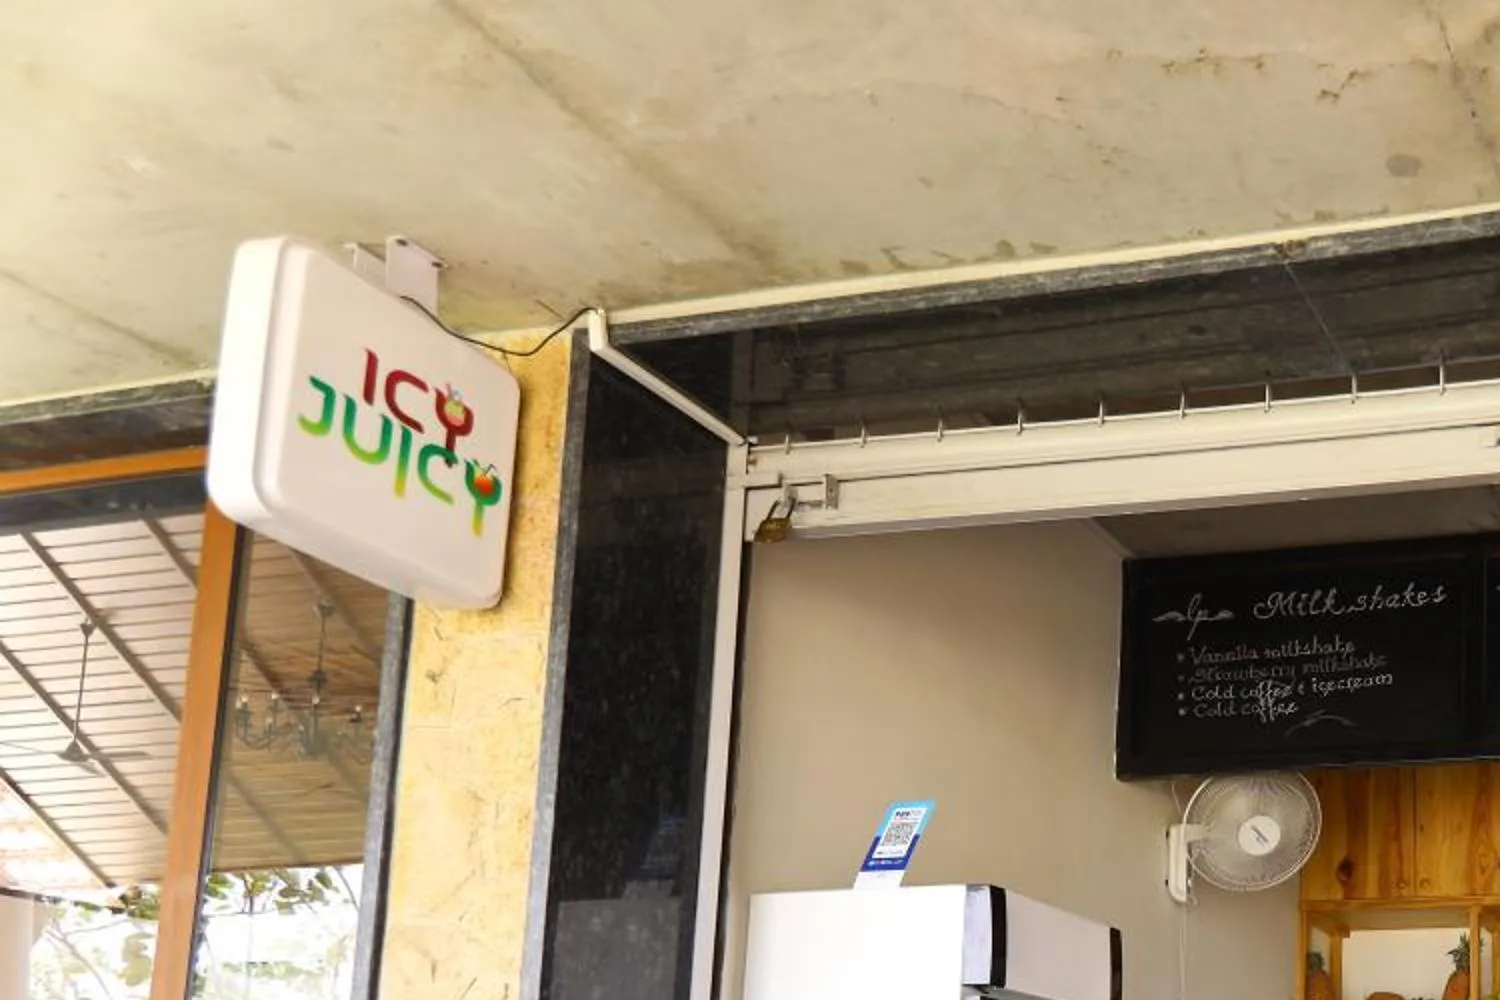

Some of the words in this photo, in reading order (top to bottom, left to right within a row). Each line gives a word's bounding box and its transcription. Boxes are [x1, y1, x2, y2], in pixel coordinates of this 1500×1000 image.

[364, 347, 474, 468] ICY
[296, 374, 503, 538] JUICY
[1252, 588, 1346, 619] Milk
[1191, 683, 1236, 701] Cold
[1241, 679, 1293, 705] coffee
[1193, 700, 1236, 718] Cold
[1241, 698, 1299, 723] coffee
